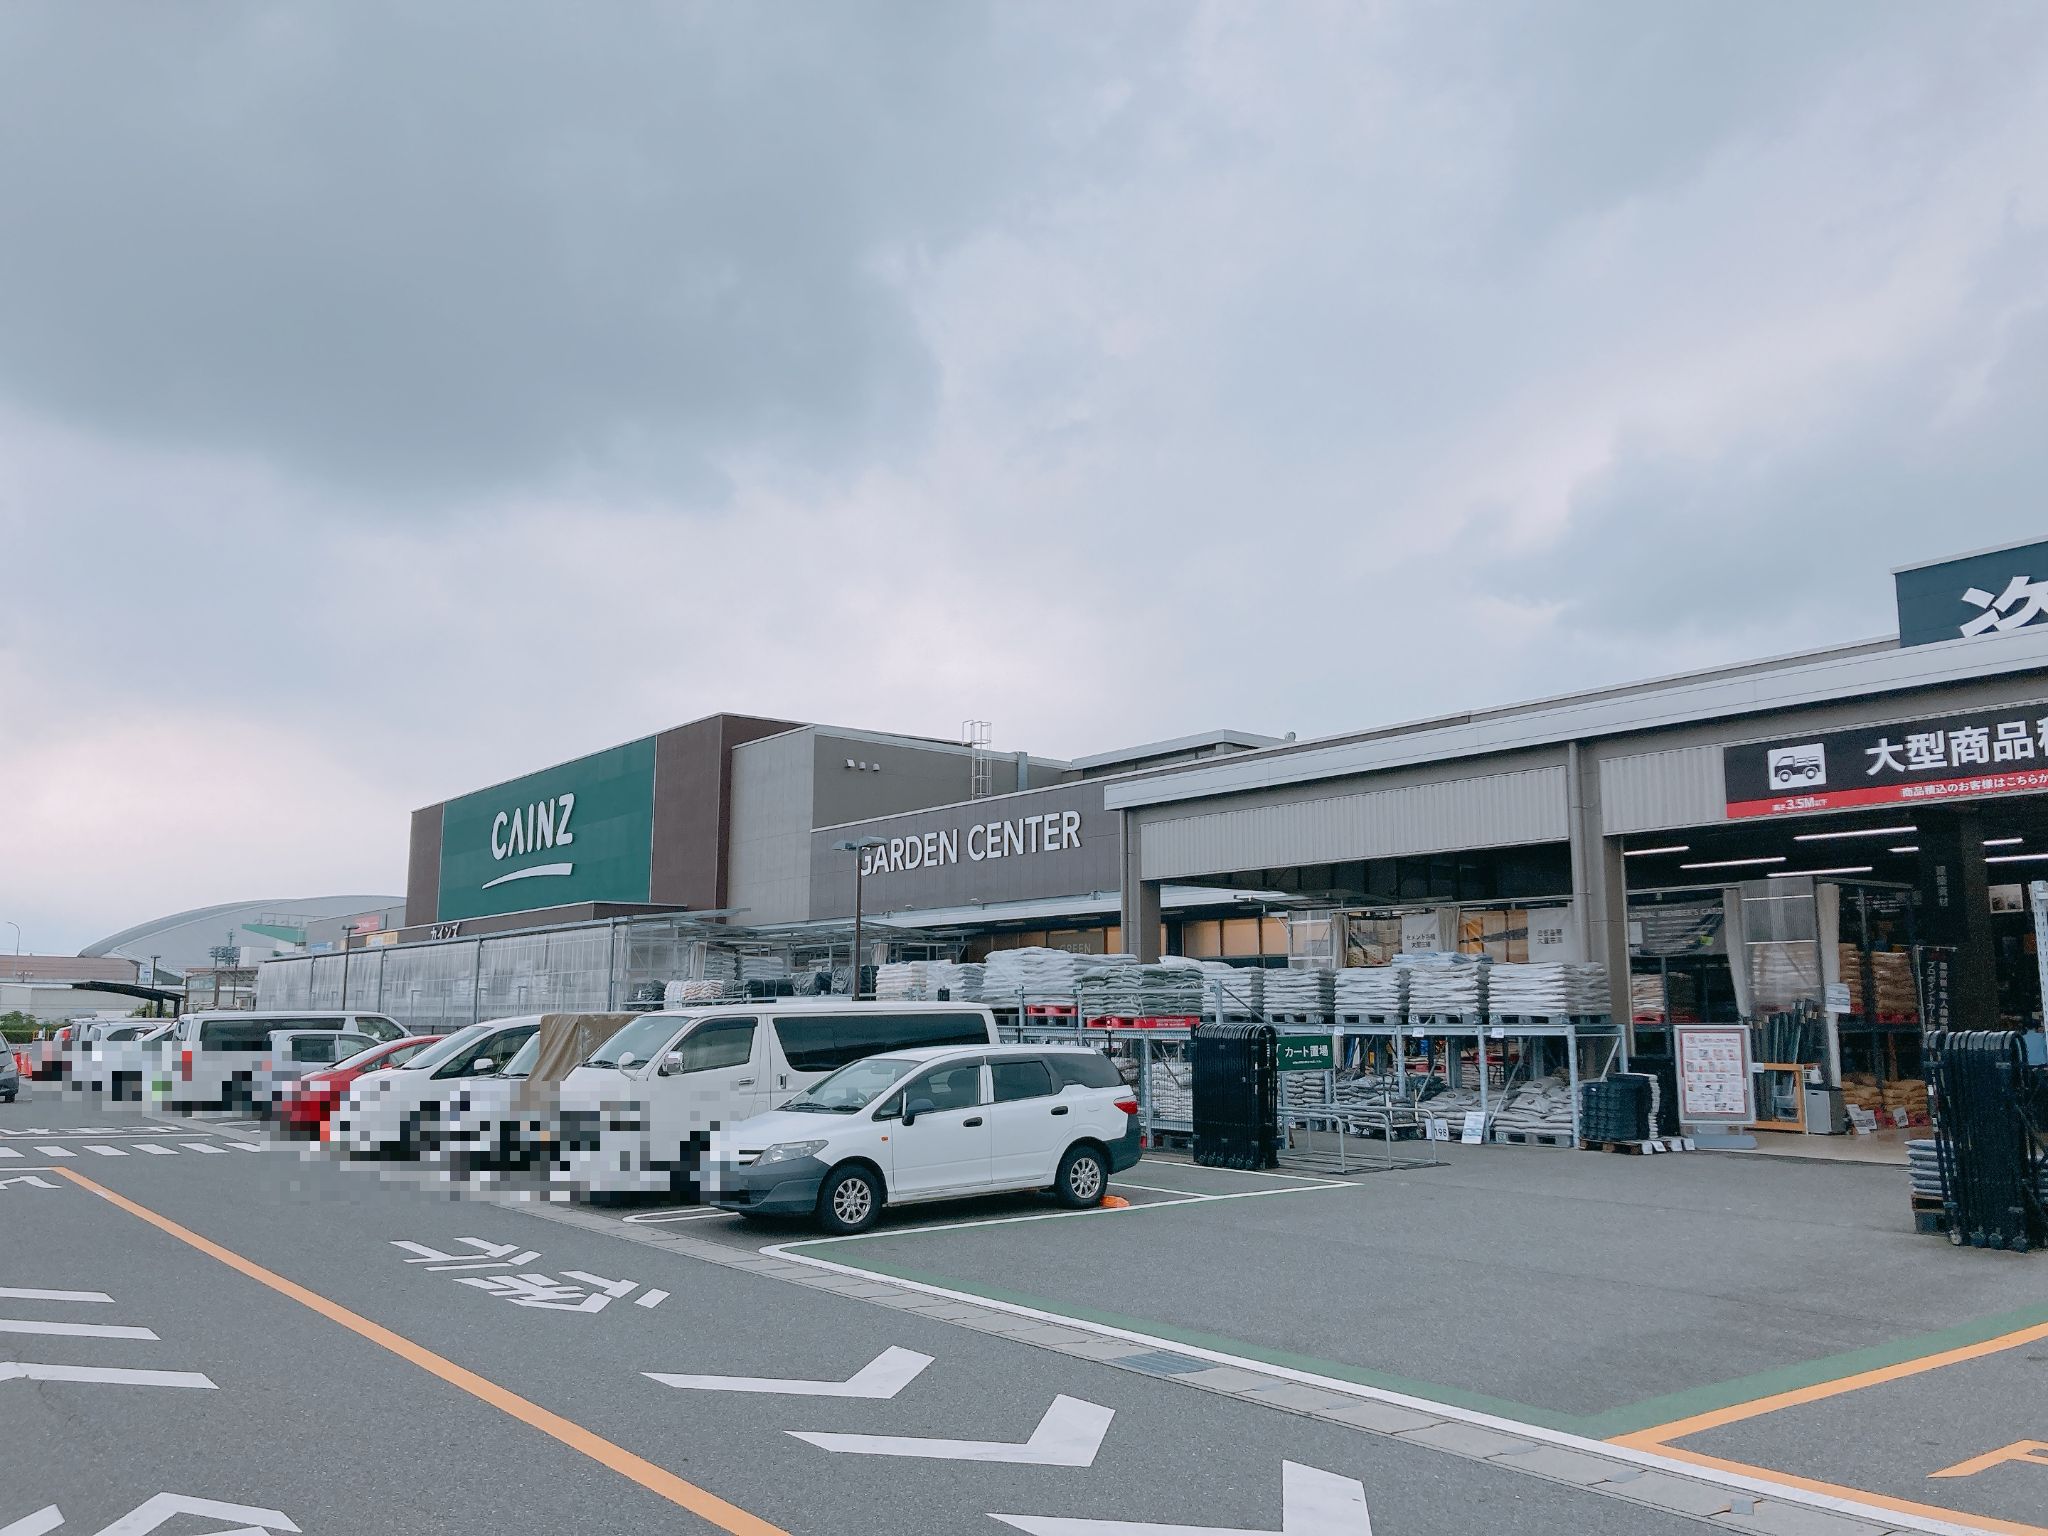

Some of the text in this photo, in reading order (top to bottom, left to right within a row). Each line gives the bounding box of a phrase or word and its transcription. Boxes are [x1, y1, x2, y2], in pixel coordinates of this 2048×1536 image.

[491, 793, 575, 860] CAINZ
[861, 811, 1082, 876] GARDEN CENTER
[430, 922, 460, 940] カインズ
[1284, 1044, 1329, 1058] カート置場
